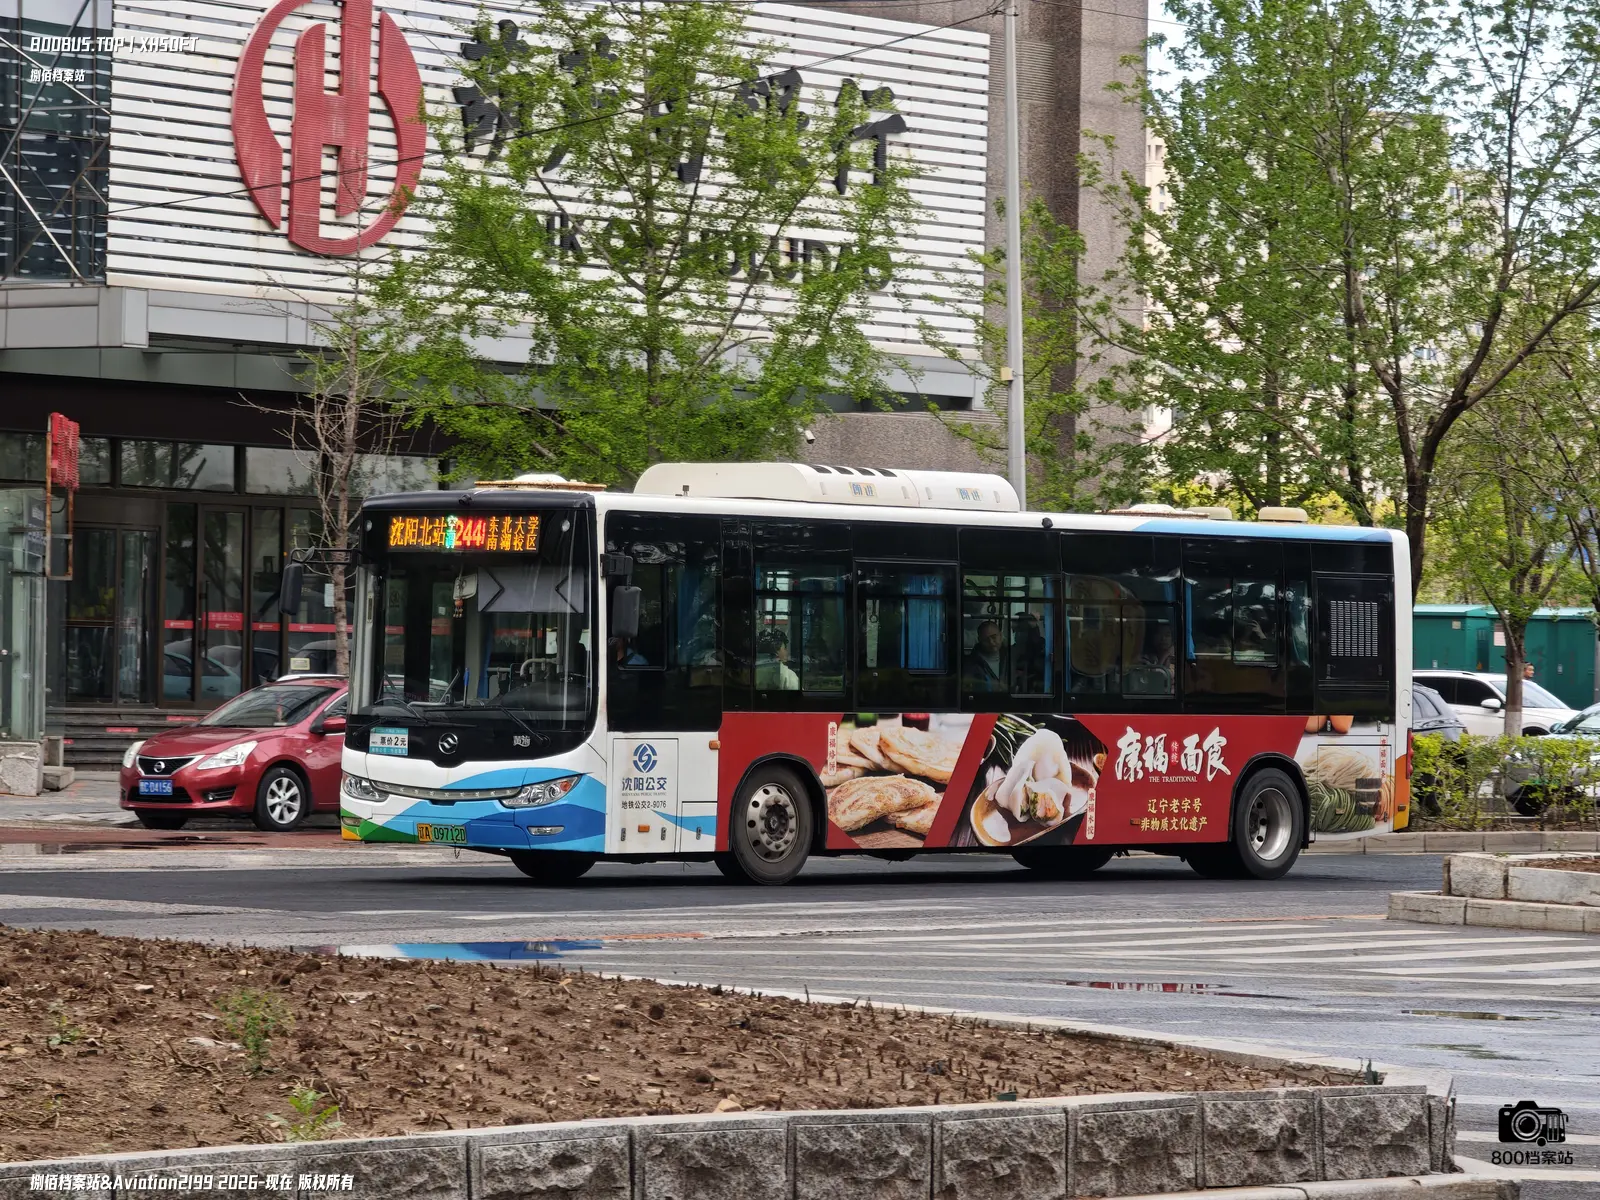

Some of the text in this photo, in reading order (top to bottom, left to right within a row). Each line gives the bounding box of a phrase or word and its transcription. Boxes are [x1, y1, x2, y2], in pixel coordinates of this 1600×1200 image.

[389, 516, 447, 547] 沈阳北站
[489, 516, 540, 535] 东北大学
[487, 533, 537, 551] 南湖校区
[1115, 725, 1169, 783] 康福
[1180, 726, 1232, 782] 面食
[621, 777, 668, 791] 沈阳公交
[621, 800, 667, 810] 地铁公交2-9076
[1147, 797, 1203, 814] 辽宁老字号
[1140, 816, 1208, 832] 非物质文化遗产
